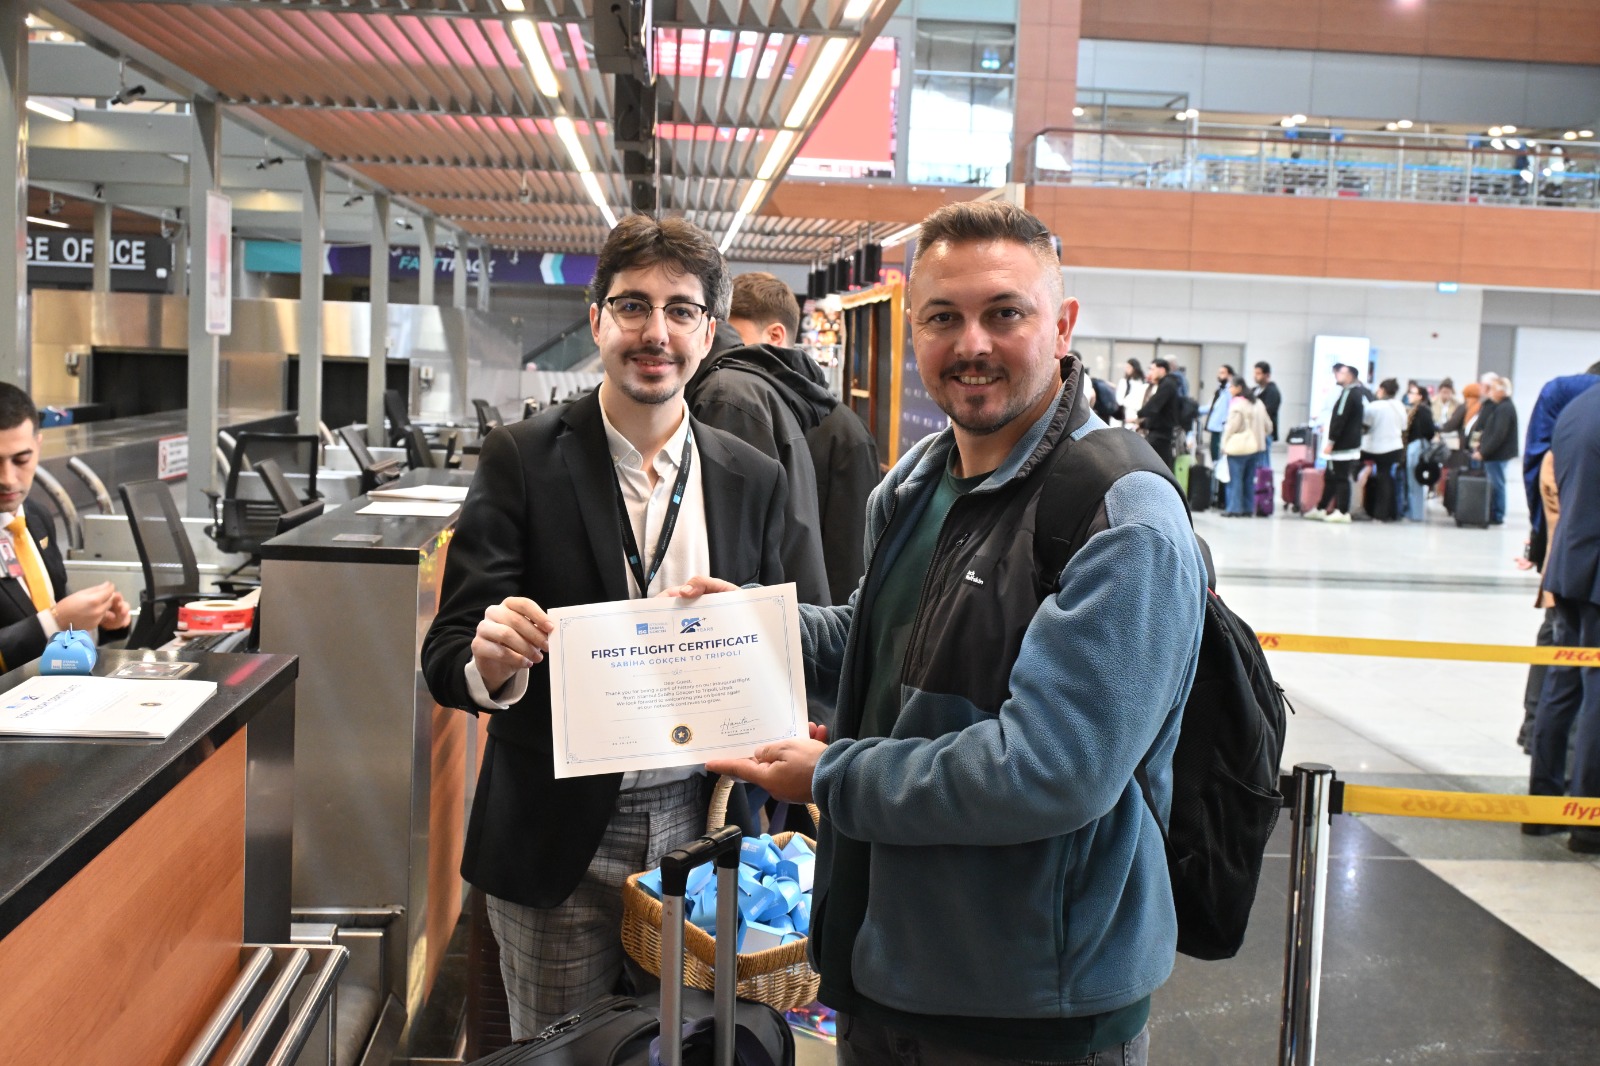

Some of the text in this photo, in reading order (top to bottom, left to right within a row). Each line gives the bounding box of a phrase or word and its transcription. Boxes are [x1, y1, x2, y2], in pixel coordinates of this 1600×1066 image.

[62, 237, 146, 265] OFICE
[591, 634, 758, 659] FIRST FLIGHT CERTIFICATE
